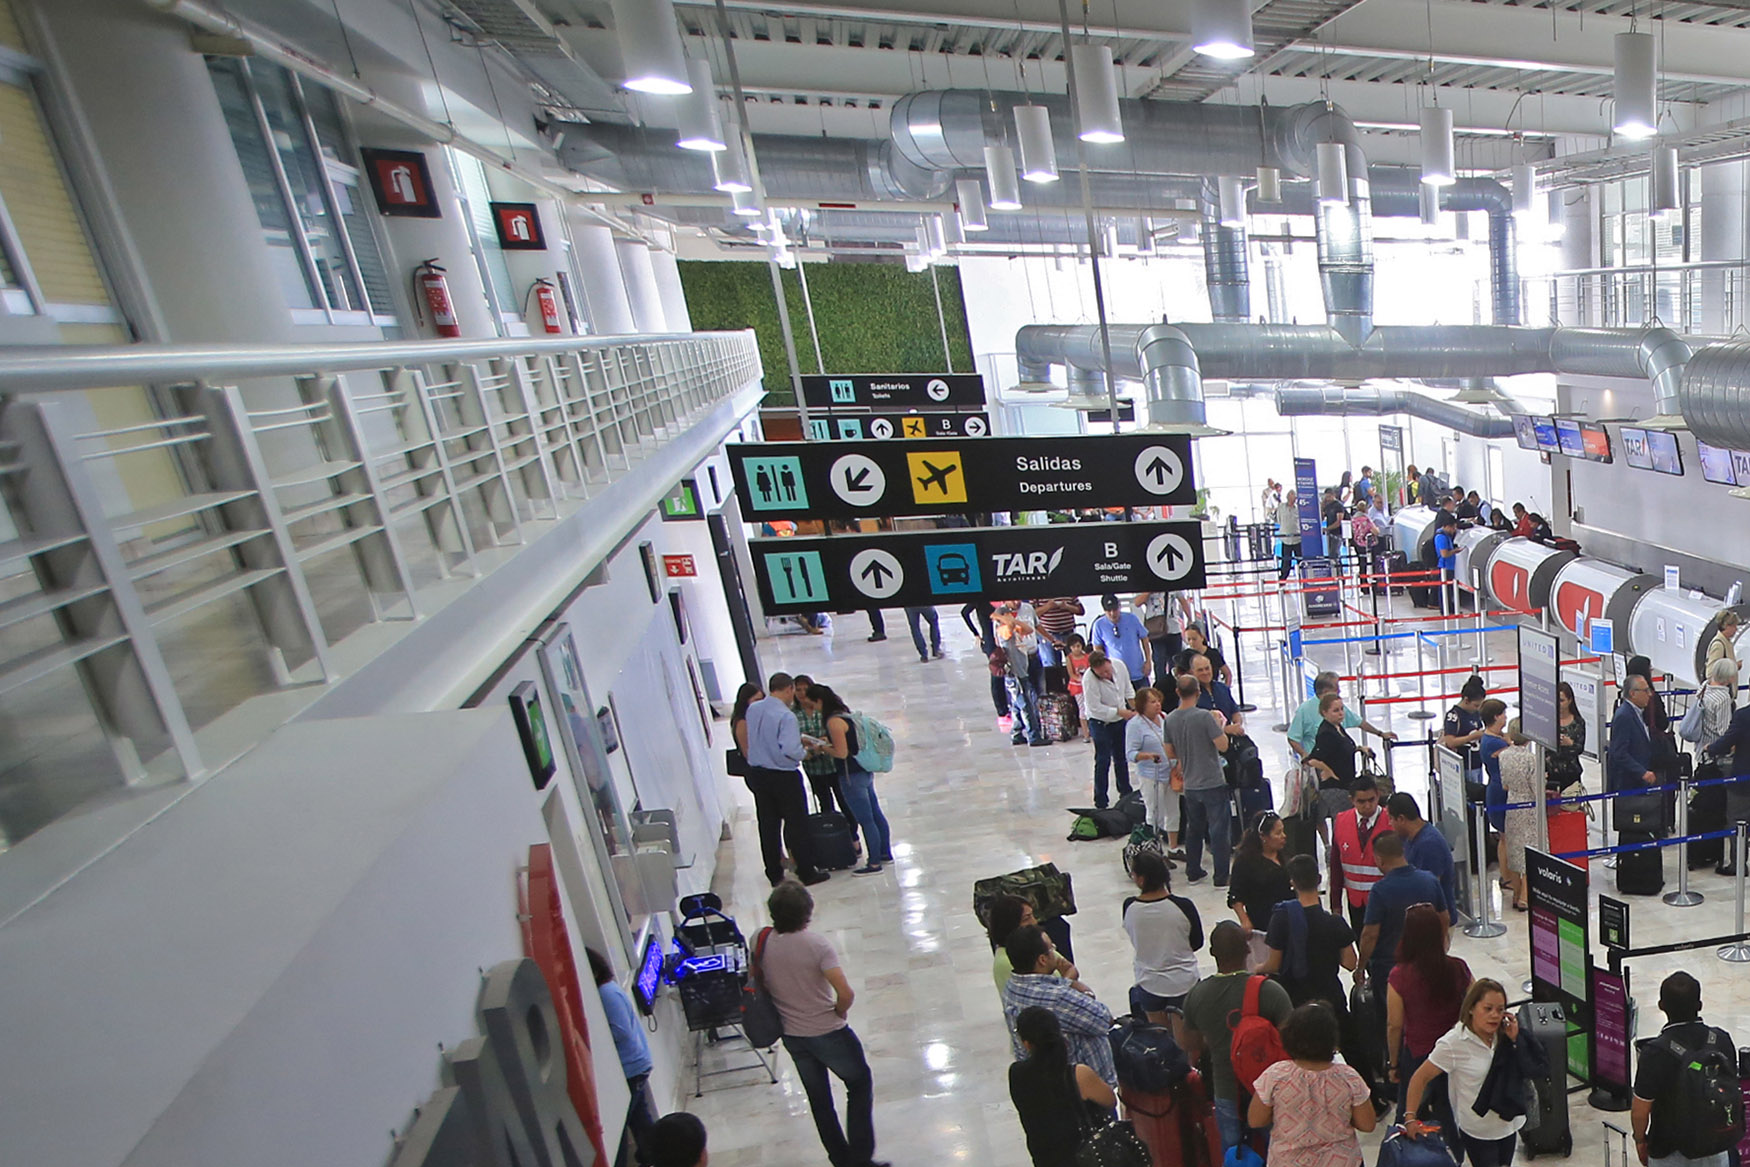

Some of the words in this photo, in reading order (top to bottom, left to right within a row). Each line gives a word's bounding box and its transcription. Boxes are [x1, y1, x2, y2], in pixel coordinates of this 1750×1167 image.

[870, 382, 910, 391] Sanitarios
[942, 419, 951, 430] B
[1624, 437, 1642, 456] TAR
[1016, 456, 1082, 472] Salidas
[1019, 480, 1093, 495] Departures
[1104, 542, 1119, 558] B
[992, 551, 1048, 577] TAR
[1094, 562, 1132, 571] Sala/Gate
[1100, 574, 1128, 583] Shuttle
[1522, 640, 1547, 654] UNITED
[1447, 712, 1458, 722] 99
[1538, 866, 1562, 885] volaris
